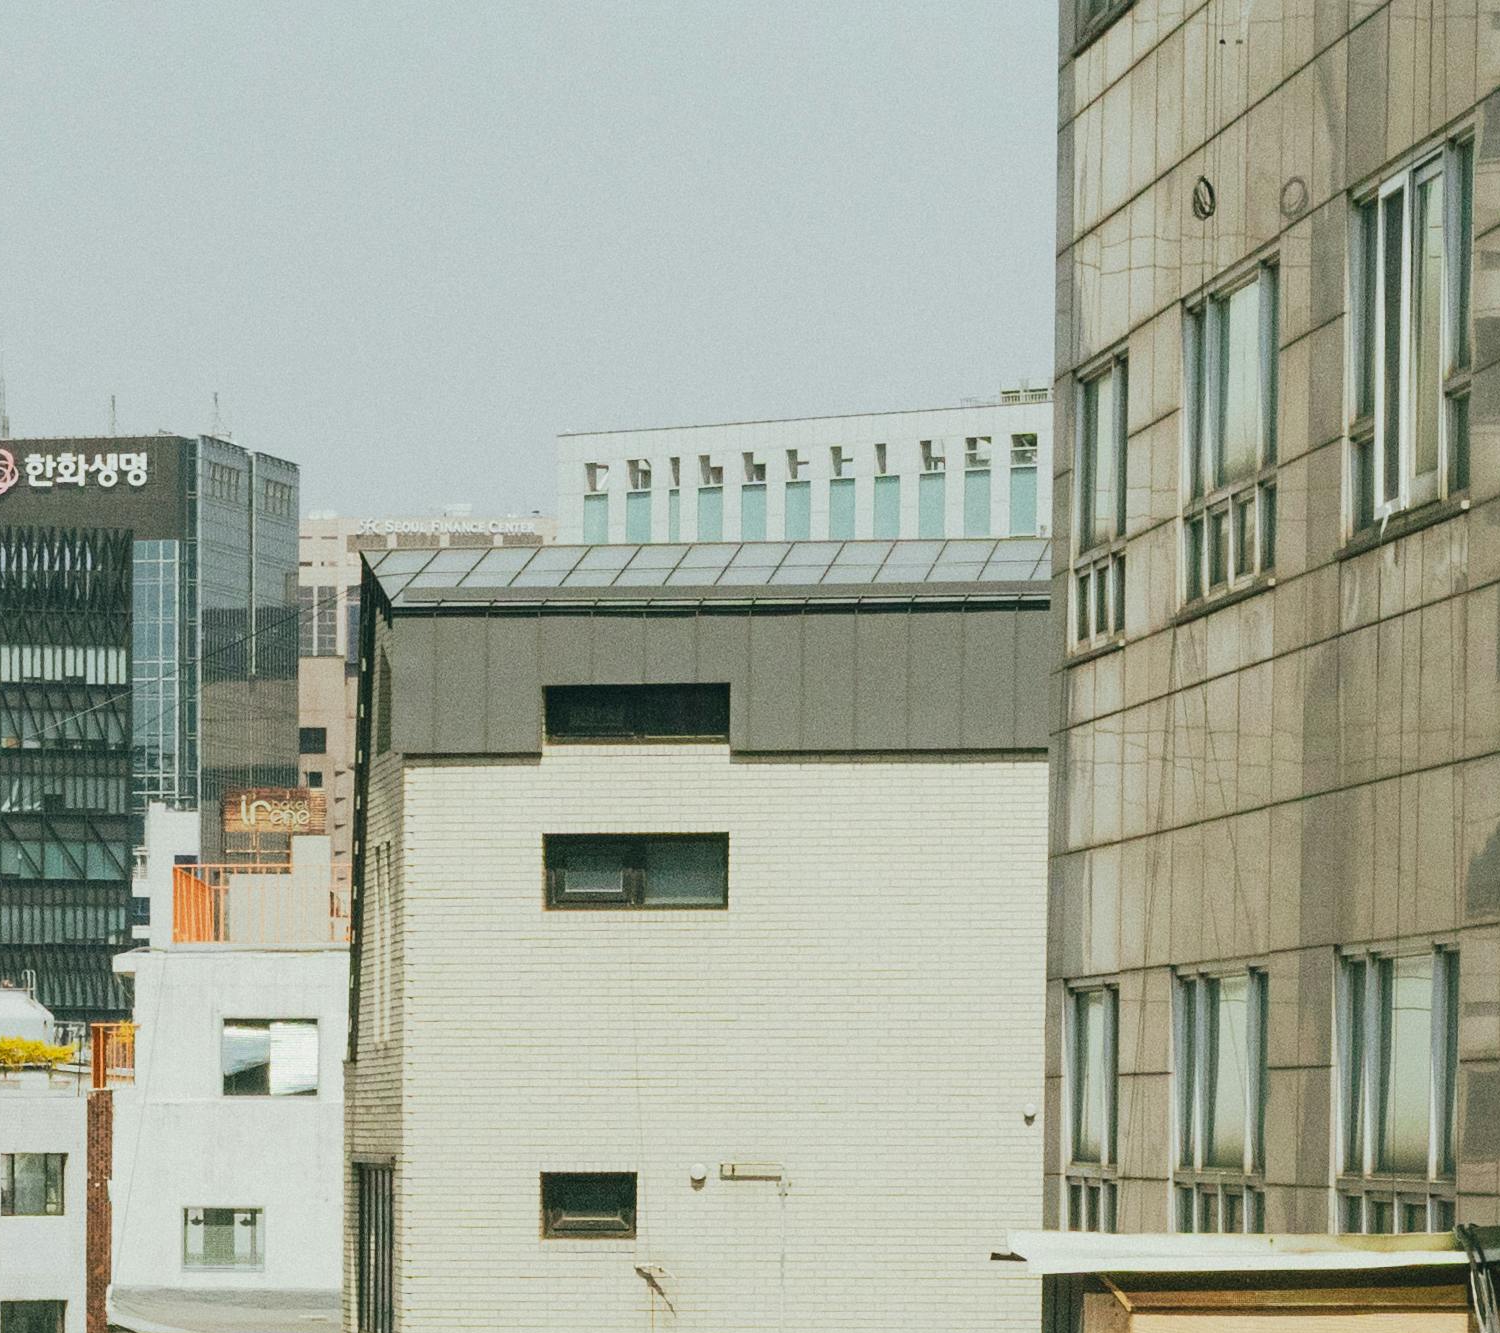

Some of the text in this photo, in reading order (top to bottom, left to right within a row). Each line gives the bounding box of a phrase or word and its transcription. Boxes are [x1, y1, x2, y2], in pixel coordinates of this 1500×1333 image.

[24, 452, 148, 487] 한화생명
[385, 520, 427, 533] SEOUL
[431, 520, 486, 533] FINANCE
[489, 520, 536, 533] CENTER
